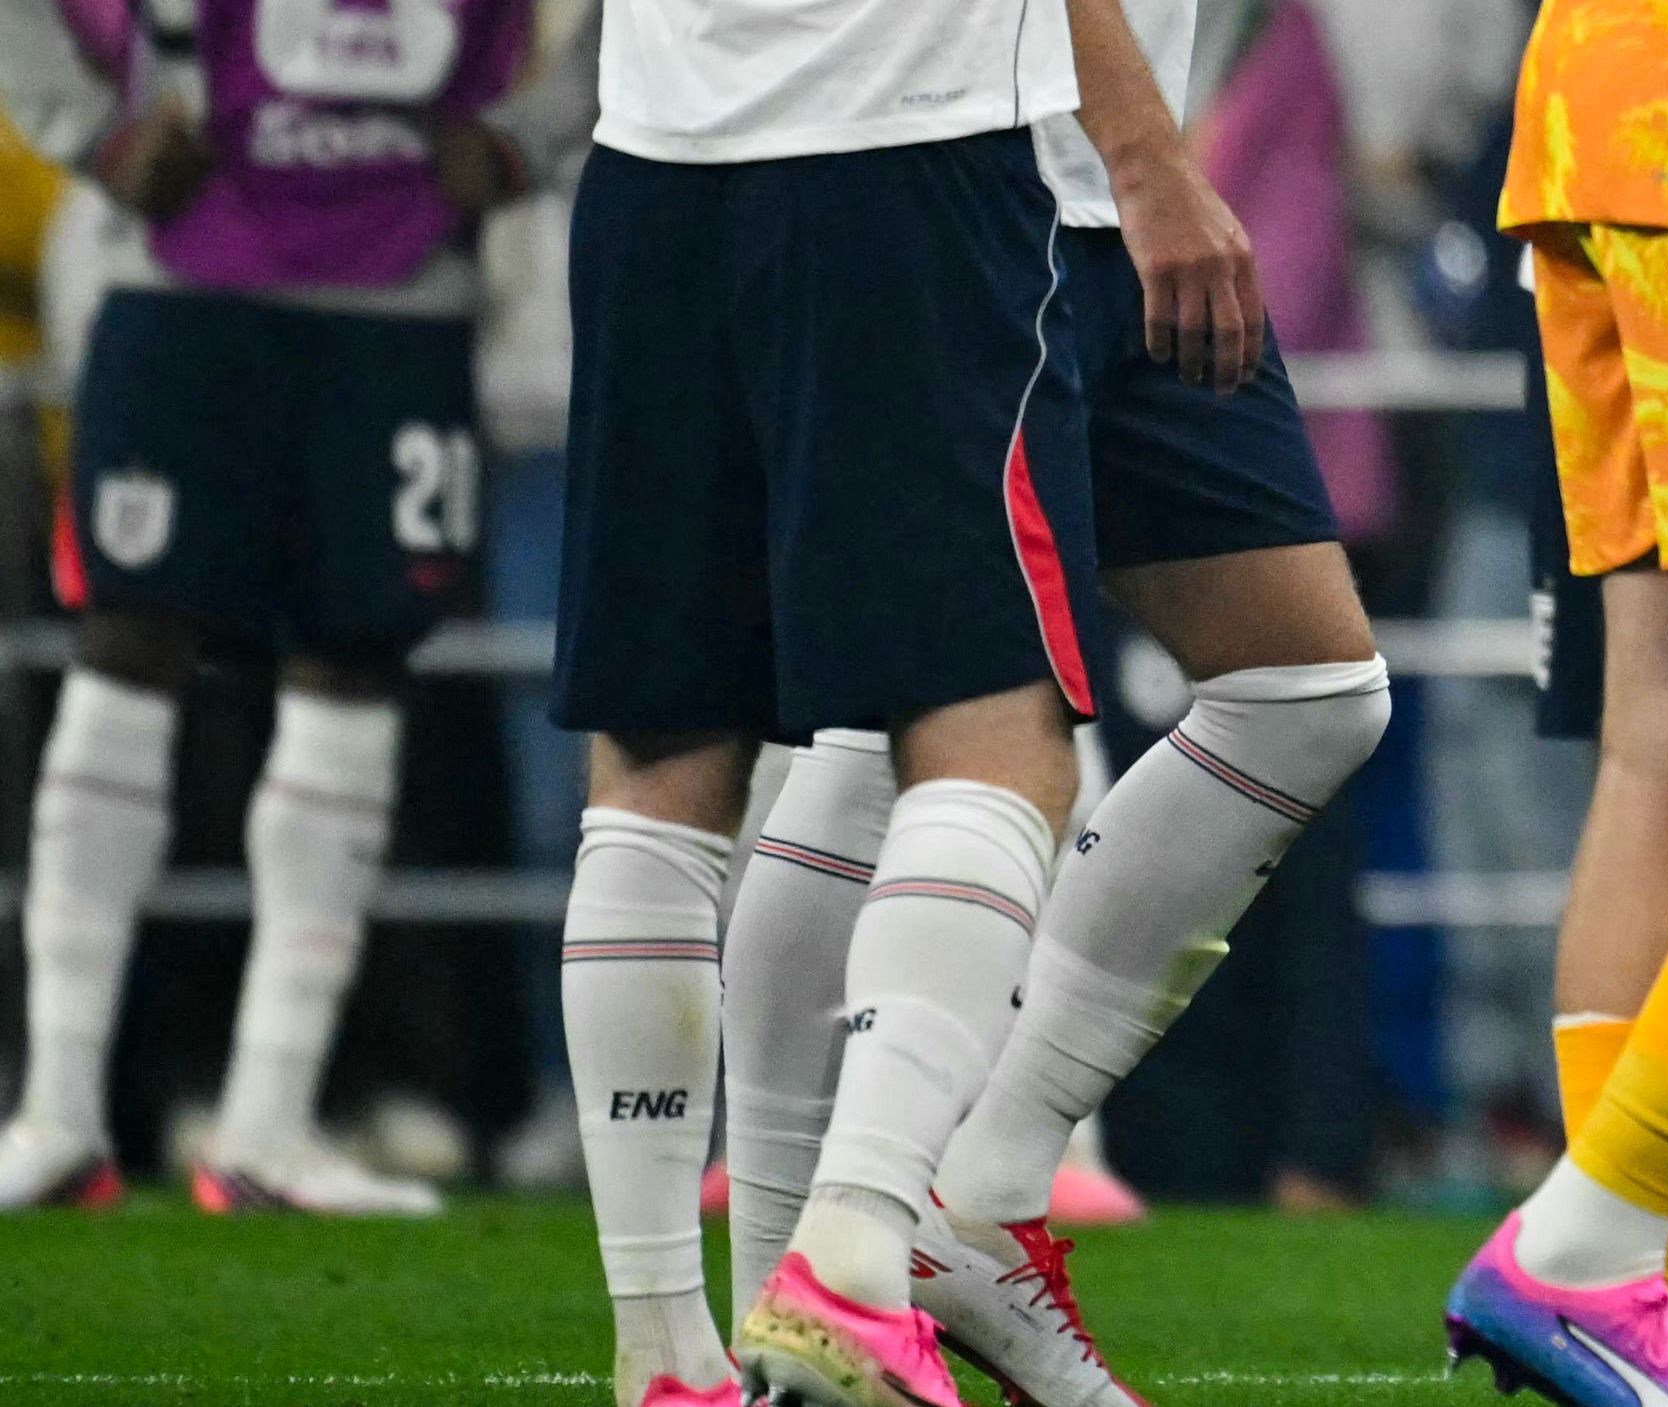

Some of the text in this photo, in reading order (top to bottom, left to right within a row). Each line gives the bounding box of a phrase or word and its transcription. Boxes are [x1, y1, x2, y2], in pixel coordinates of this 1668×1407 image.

[1076, 827, 1100, 856] NG
[847, 1008, 877, 1034] NG
[610, 1089, 688, 1120] ENG
